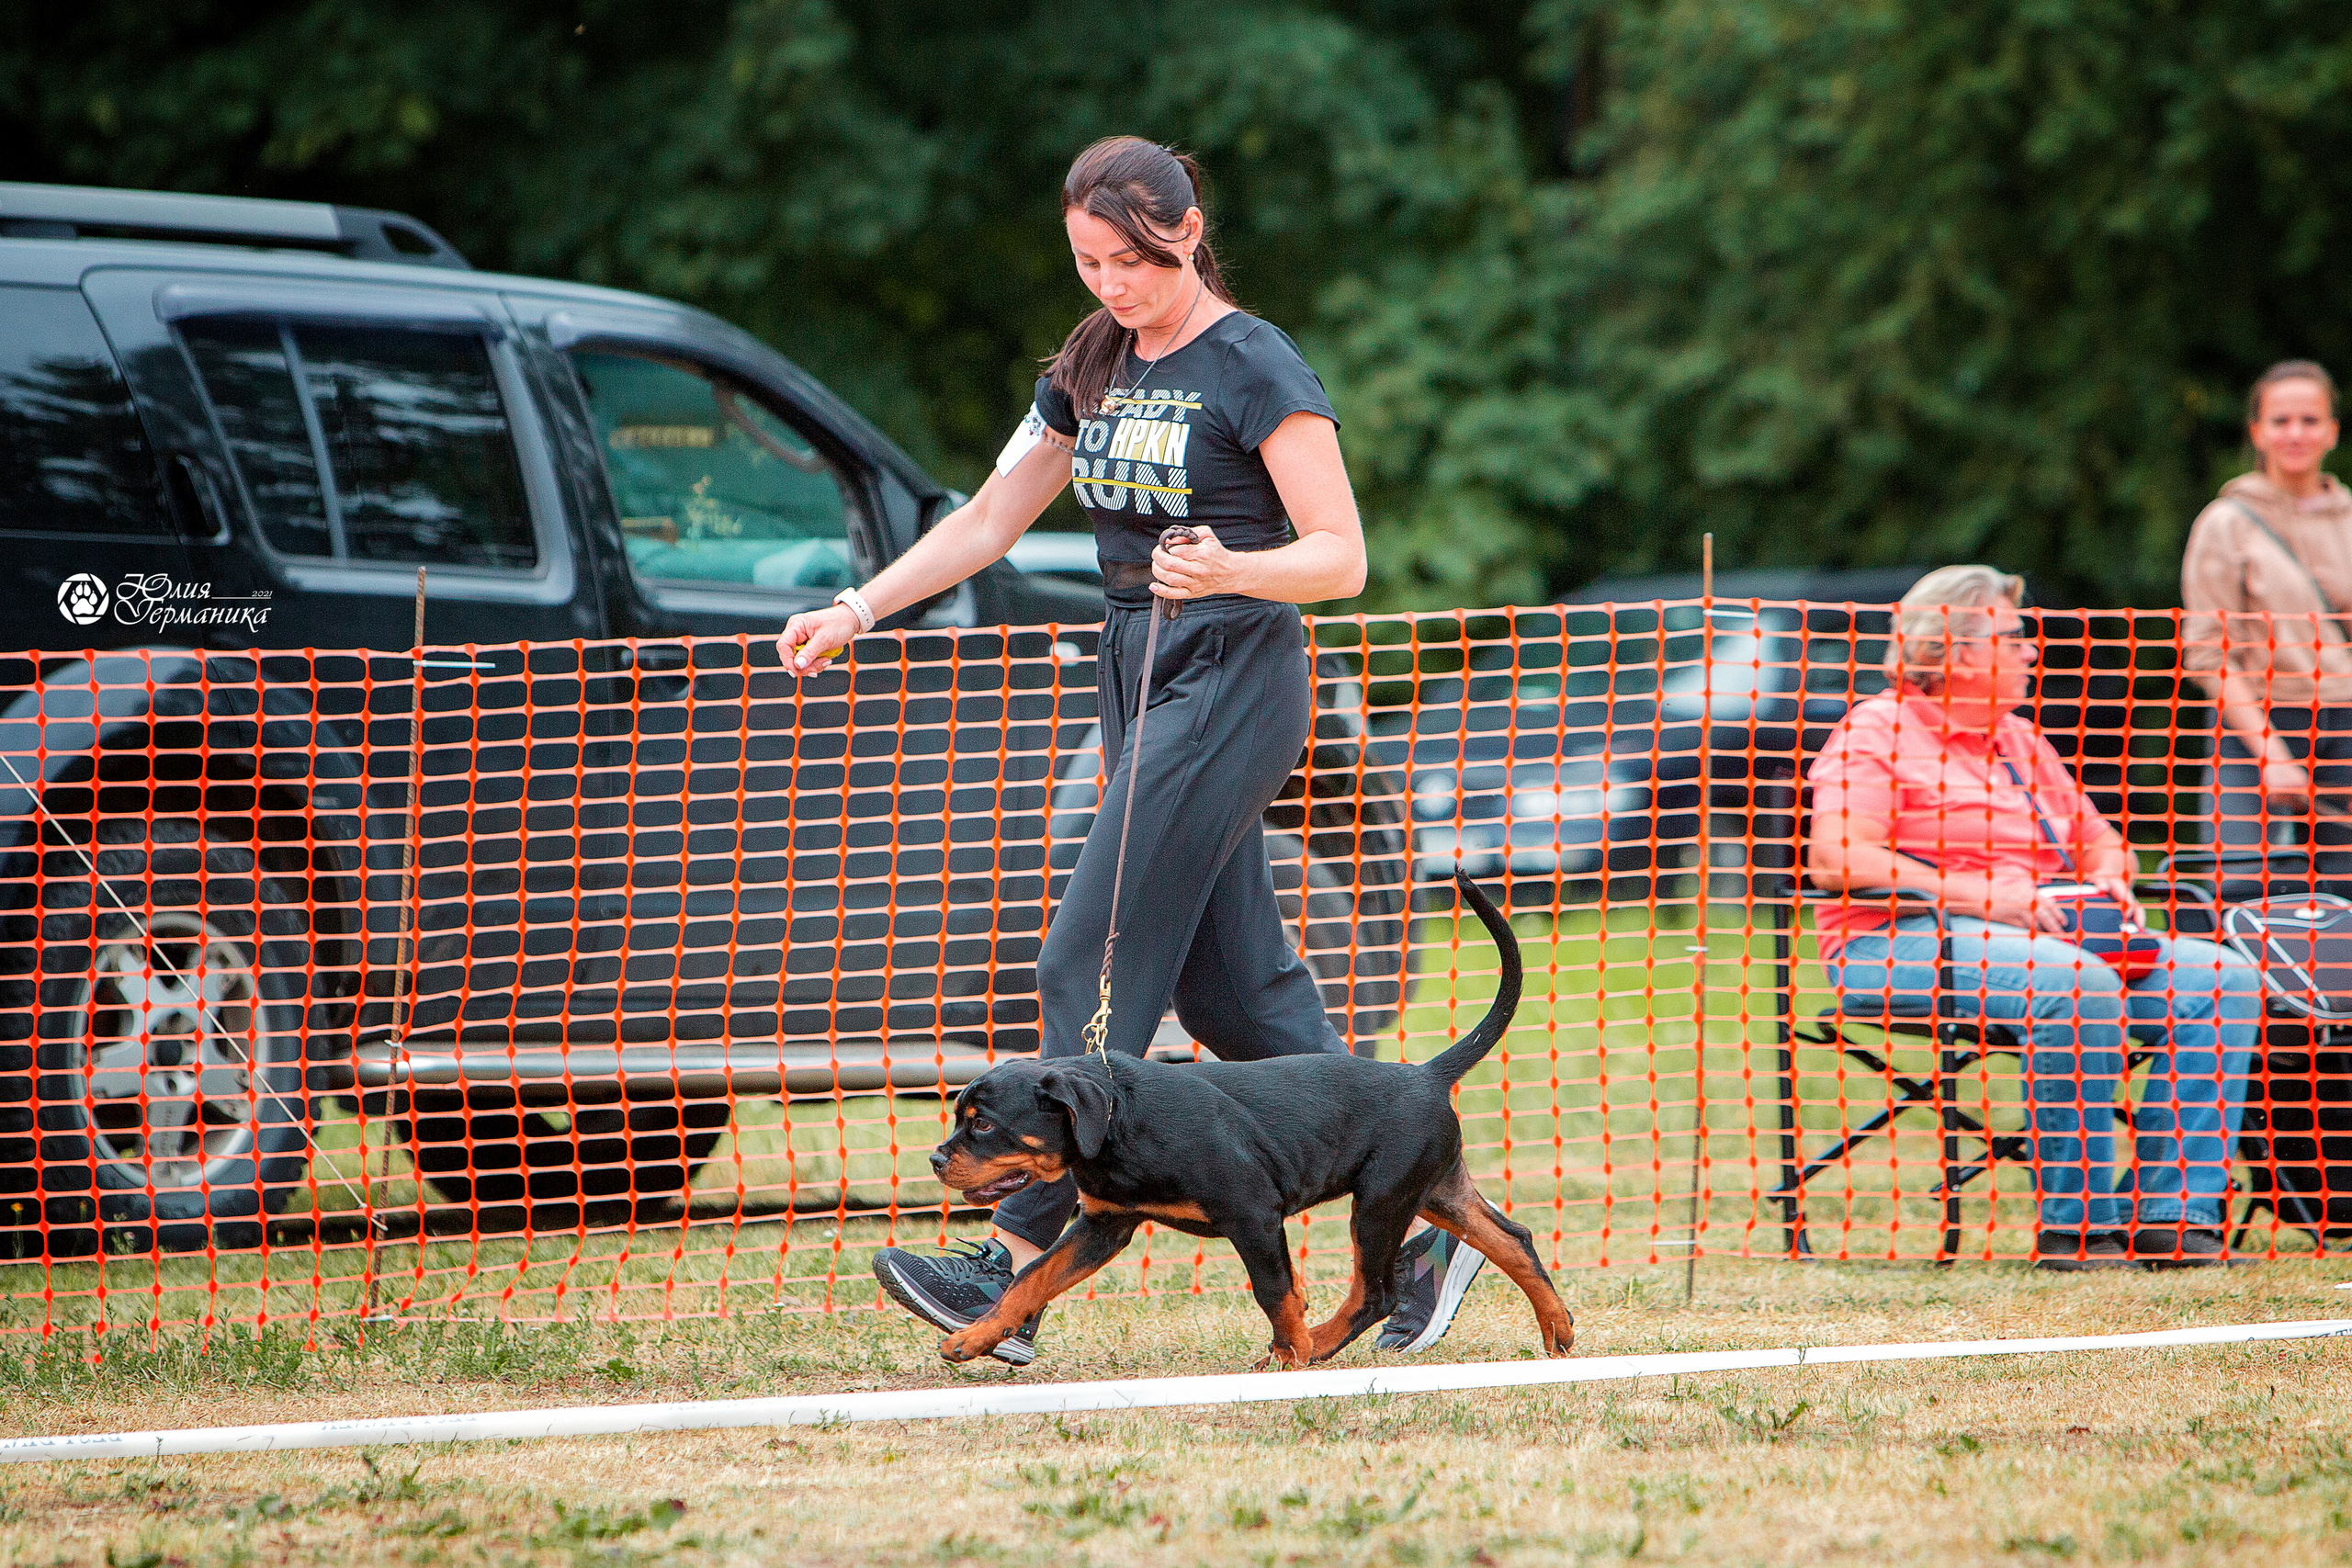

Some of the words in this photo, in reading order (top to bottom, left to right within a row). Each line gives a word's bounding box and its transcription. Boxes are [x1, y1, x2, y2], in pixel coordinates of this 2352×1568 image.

[1090, 387, 1202, 423] EADY
[1073, 418, 1110, 453] TO
[1108, 417, 1191, 468] HPKN
[1071, 457, 1191, 517] RUN
